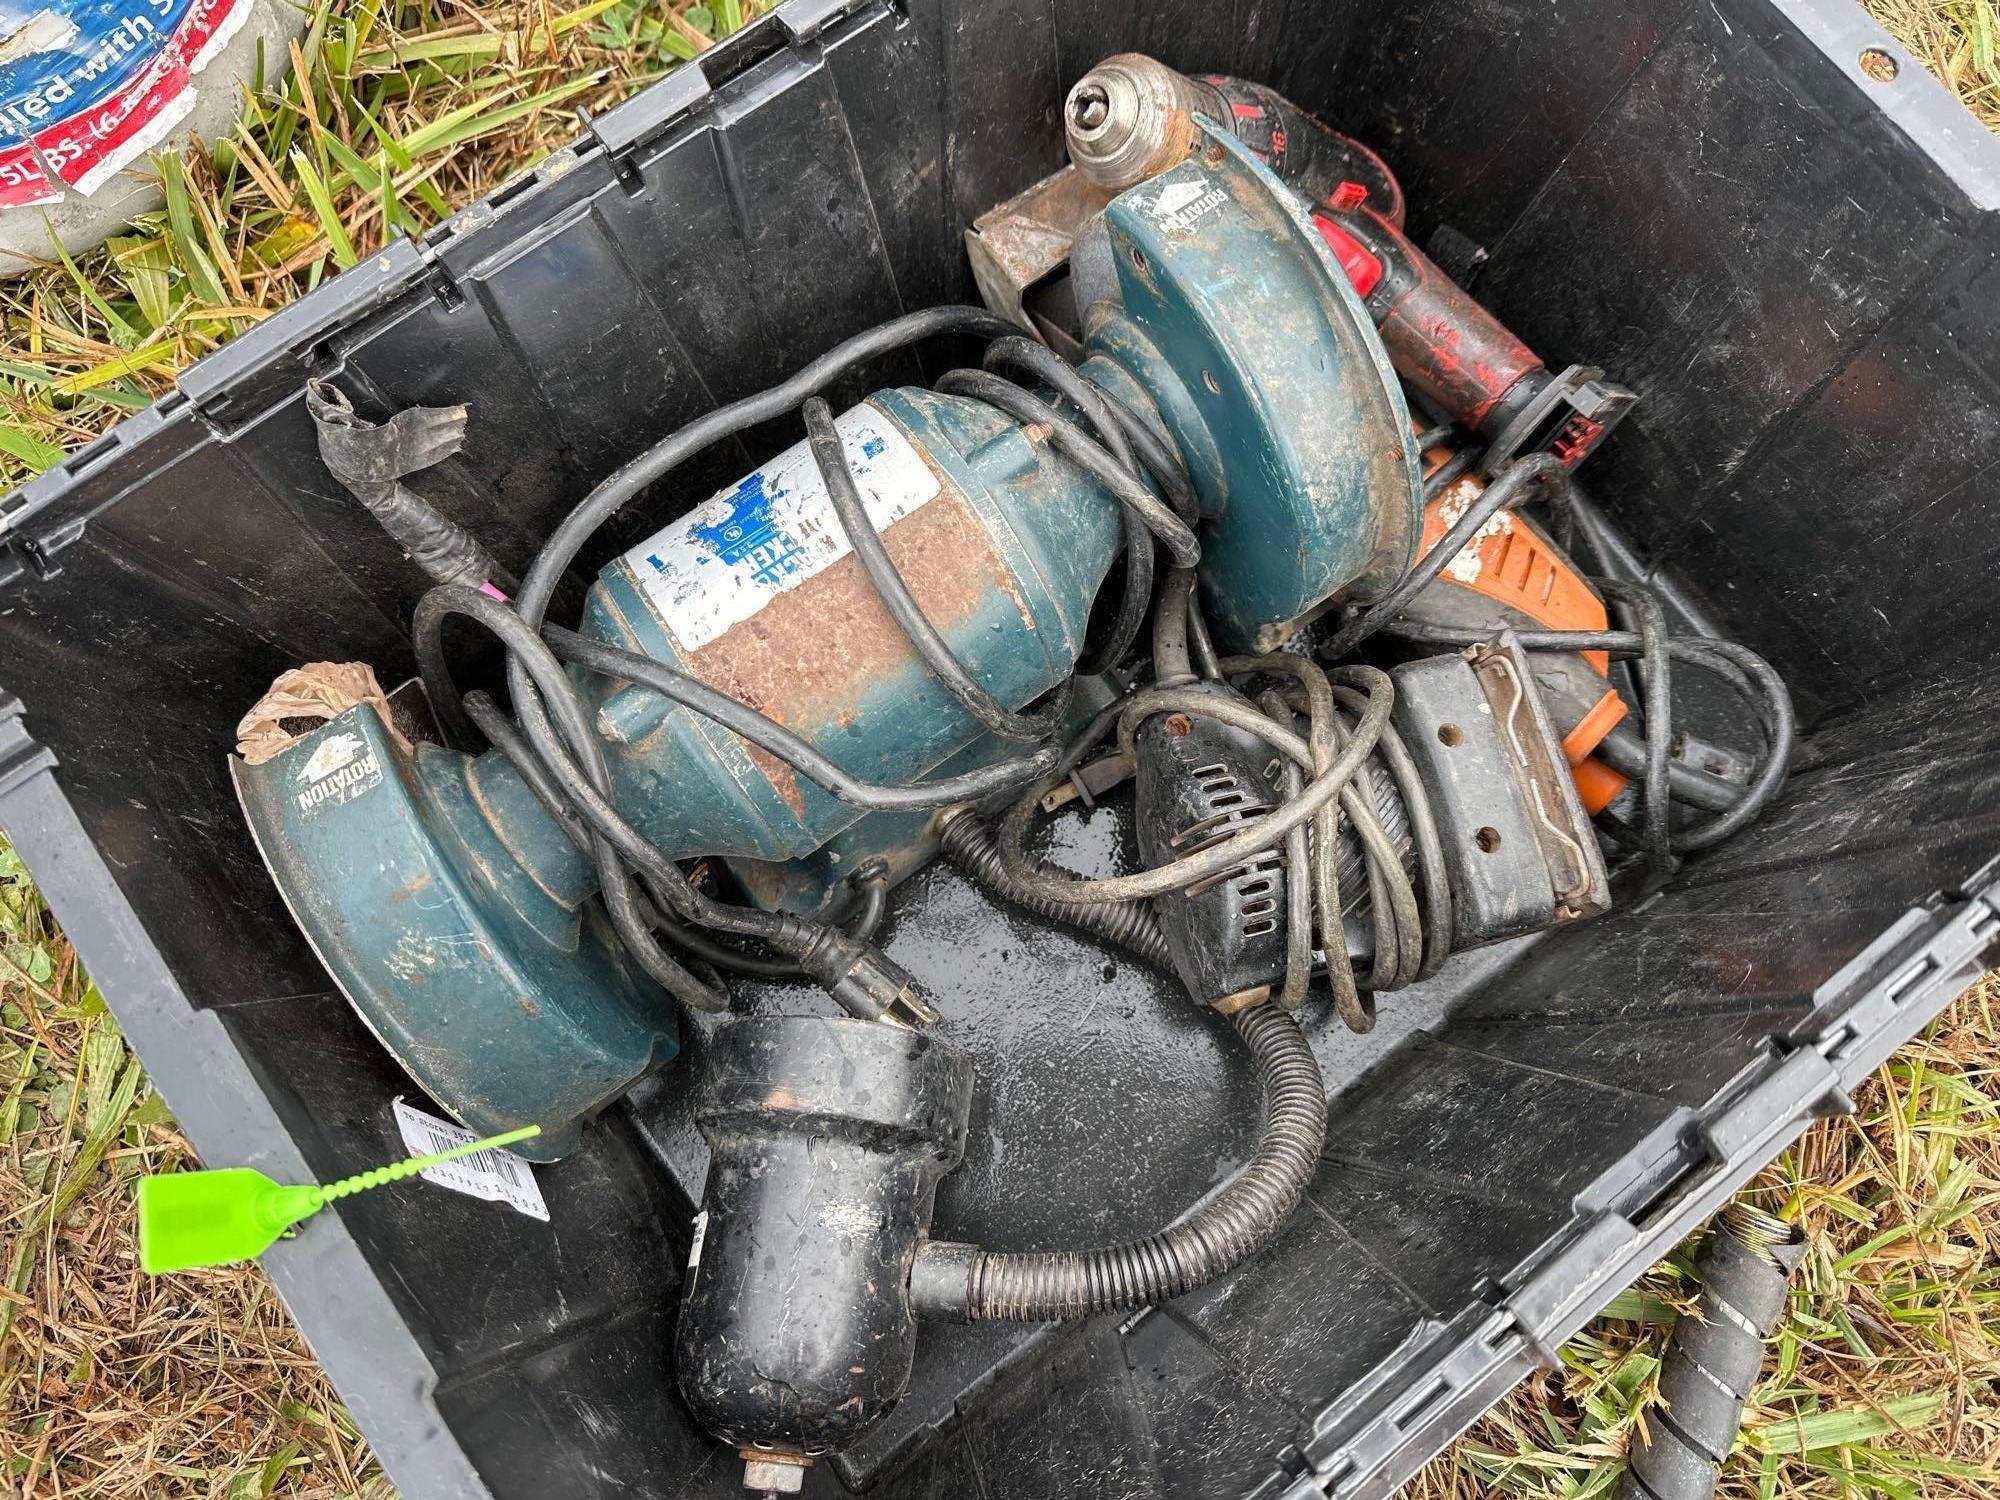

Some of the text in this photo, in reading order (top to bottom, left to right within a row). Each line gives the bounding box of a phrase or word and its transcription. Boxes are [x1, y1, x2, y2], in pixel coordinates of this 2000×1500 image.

[74, 16, 154, 82] with
[1159, 188, 1228, 233] ROTATION
[298, 757, 377, 810] ROTATION
